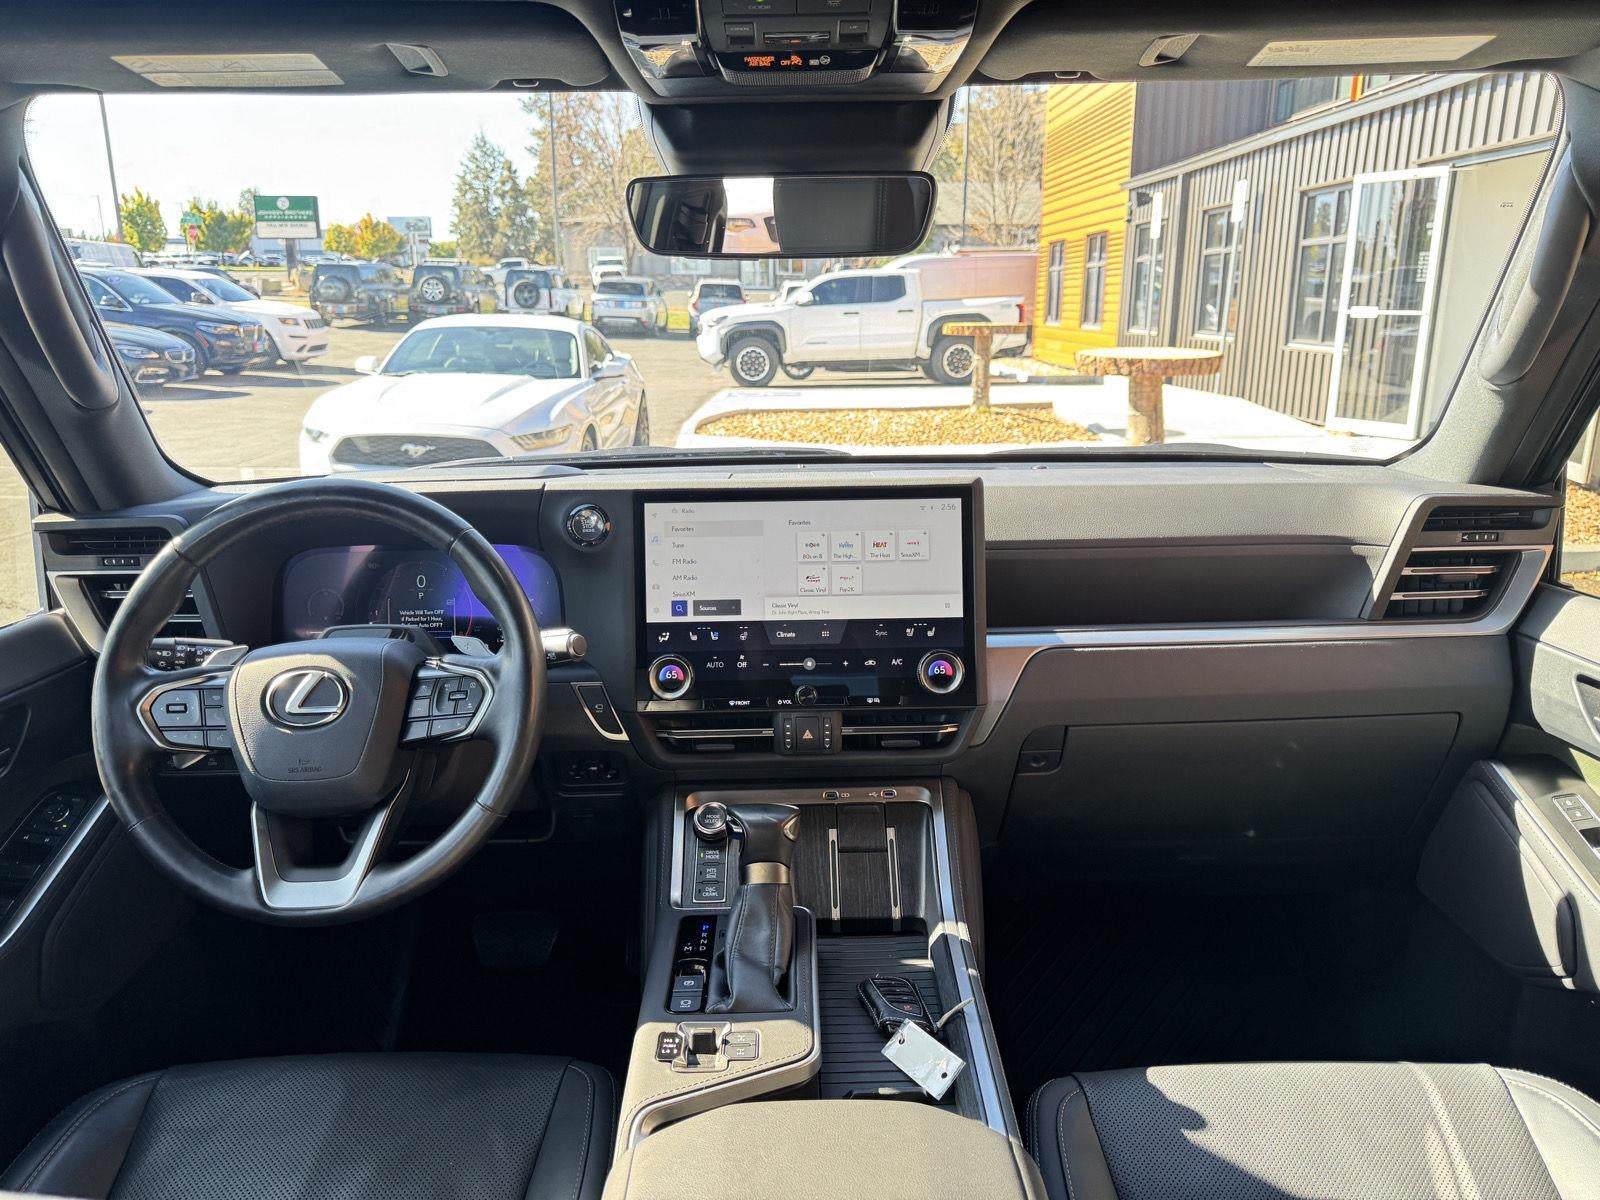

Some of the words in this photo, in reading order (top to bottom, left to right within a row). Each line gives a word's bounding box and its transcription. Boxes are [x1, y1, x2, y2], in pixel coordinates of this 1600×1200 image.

[940, 503, 957, 511] 2:56
[671, 525, 695, 533] Favorites
[416, 574, 426, 588] 0
[815, 586, 827, 594] Vinyl
[418, 592, 424, 600] P
[776, 630, 796, 638] Climate
[874, 629, 888, 637] Sync
[891, 658, 903, 666] A/C
[933, 665, 946, 674] 65
[665, 671, 678, 679] 65
